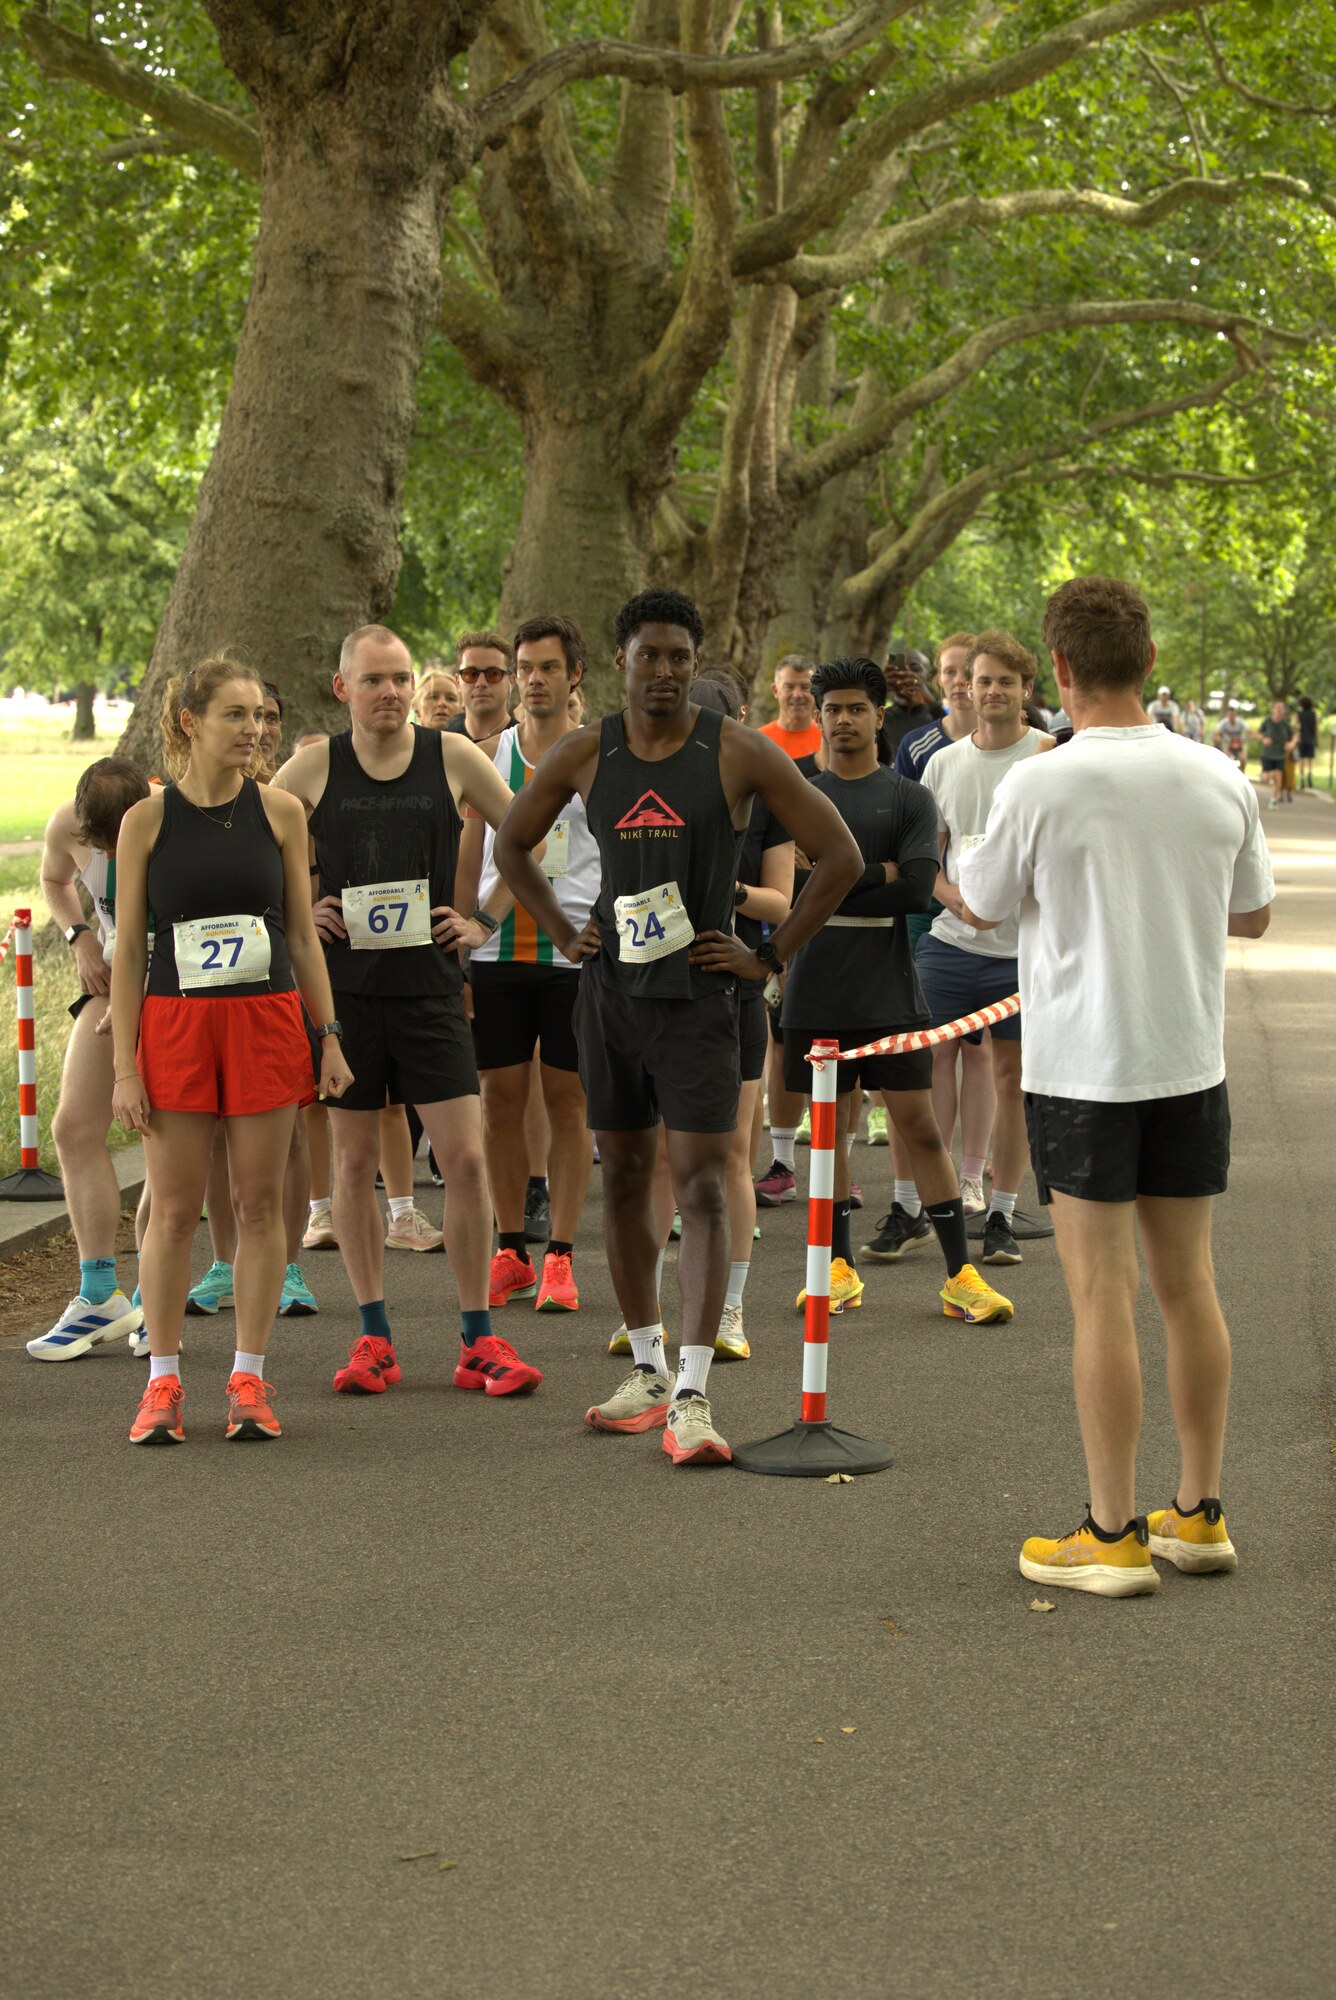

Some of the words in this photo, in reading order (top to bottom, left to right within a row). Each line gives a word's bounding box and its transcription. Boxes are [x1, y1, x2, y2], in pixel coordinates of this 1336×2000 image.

[620, 830, 642, 841] NIKE
[648, 829, 679, 839] TRAIL
[368, 888, 404, 896] AFFORDABLE
[415, 884, 421, 893] A
[662, 888, 669, 898] A
[368, 902, 409, 934] 67
[200, 921, 239, 931] AFFORDABLE
[625, 911, 666, 947] 24
[206, 929, 236, 937] RUNNING
[200, 937, 244, 970] 27
